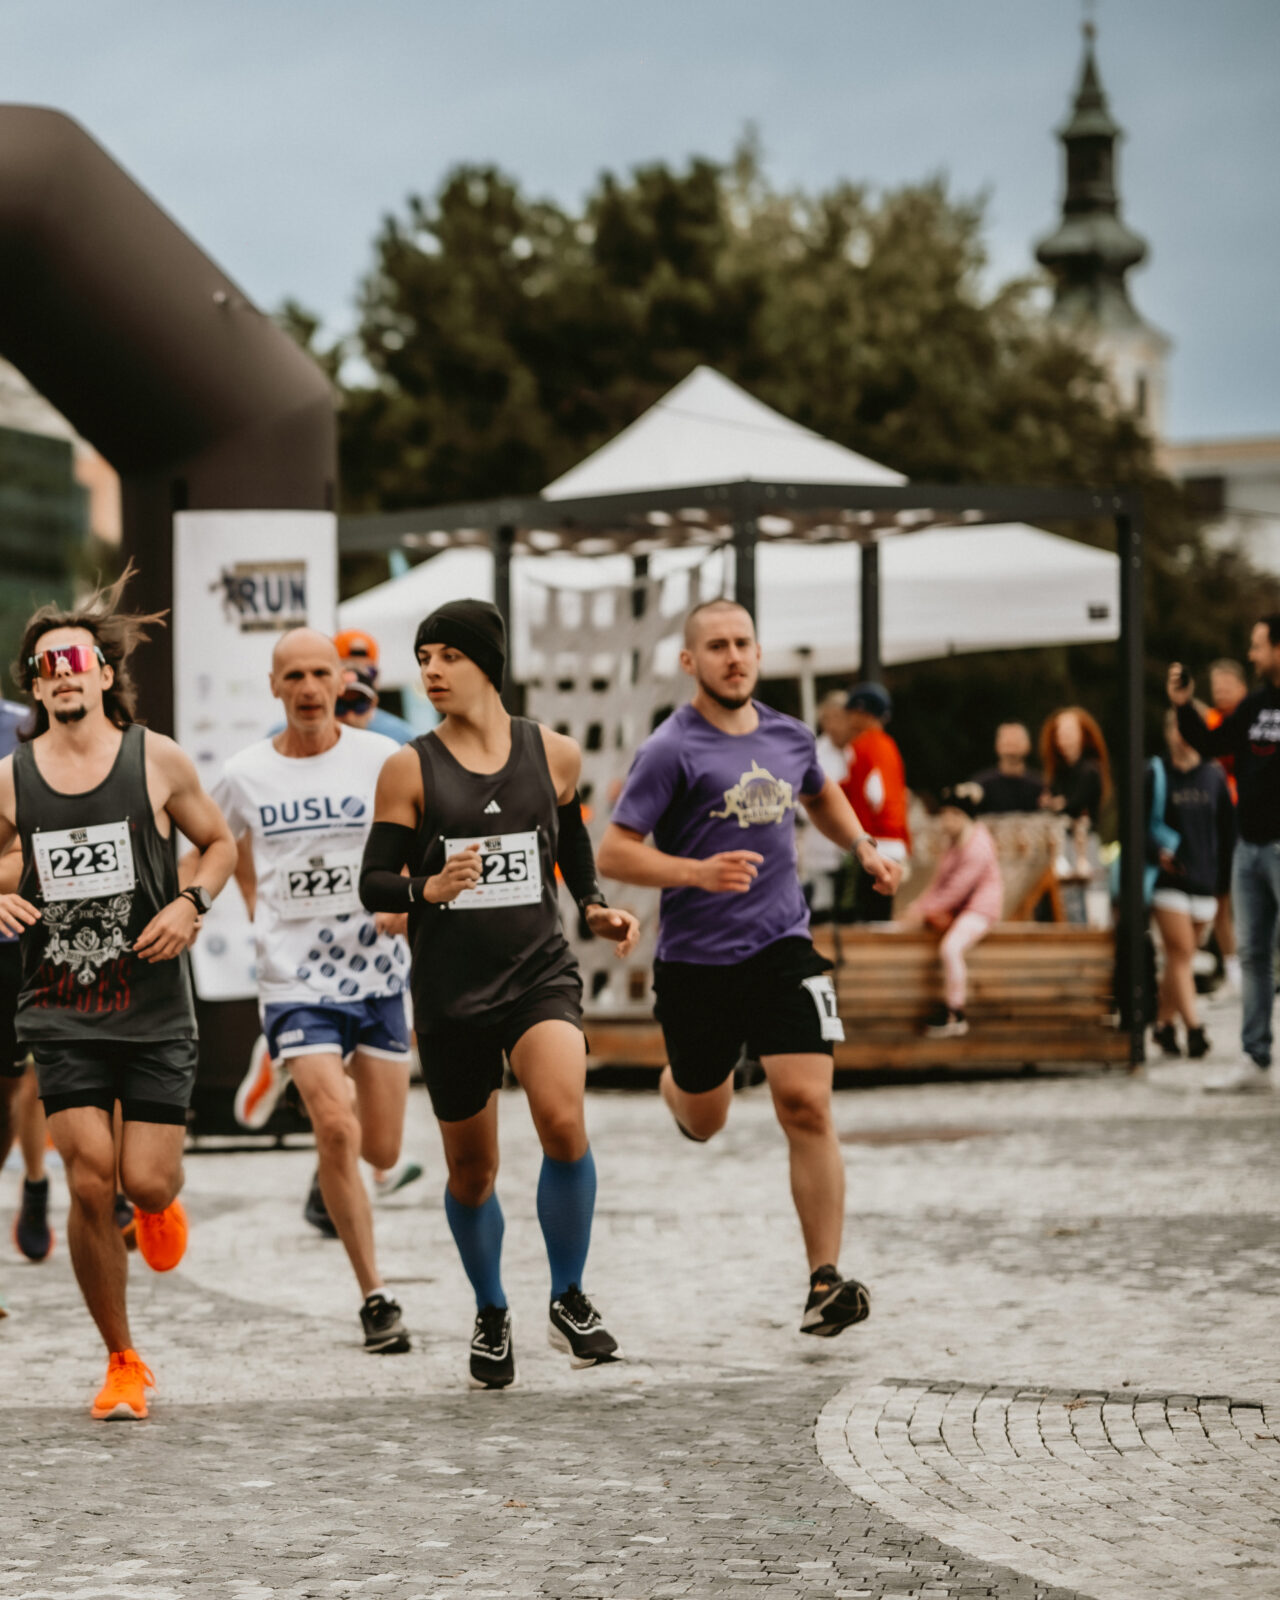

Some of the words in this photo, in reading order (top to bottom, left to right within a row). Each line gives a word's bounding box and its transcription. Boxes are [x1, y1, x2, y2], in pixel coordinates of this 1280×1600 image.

[237, 575, 307, 614] RUN
[51, 842, 117, 877] 223
[477, 852, 528, 884] 25
[290, 867, 352, 898] 222
